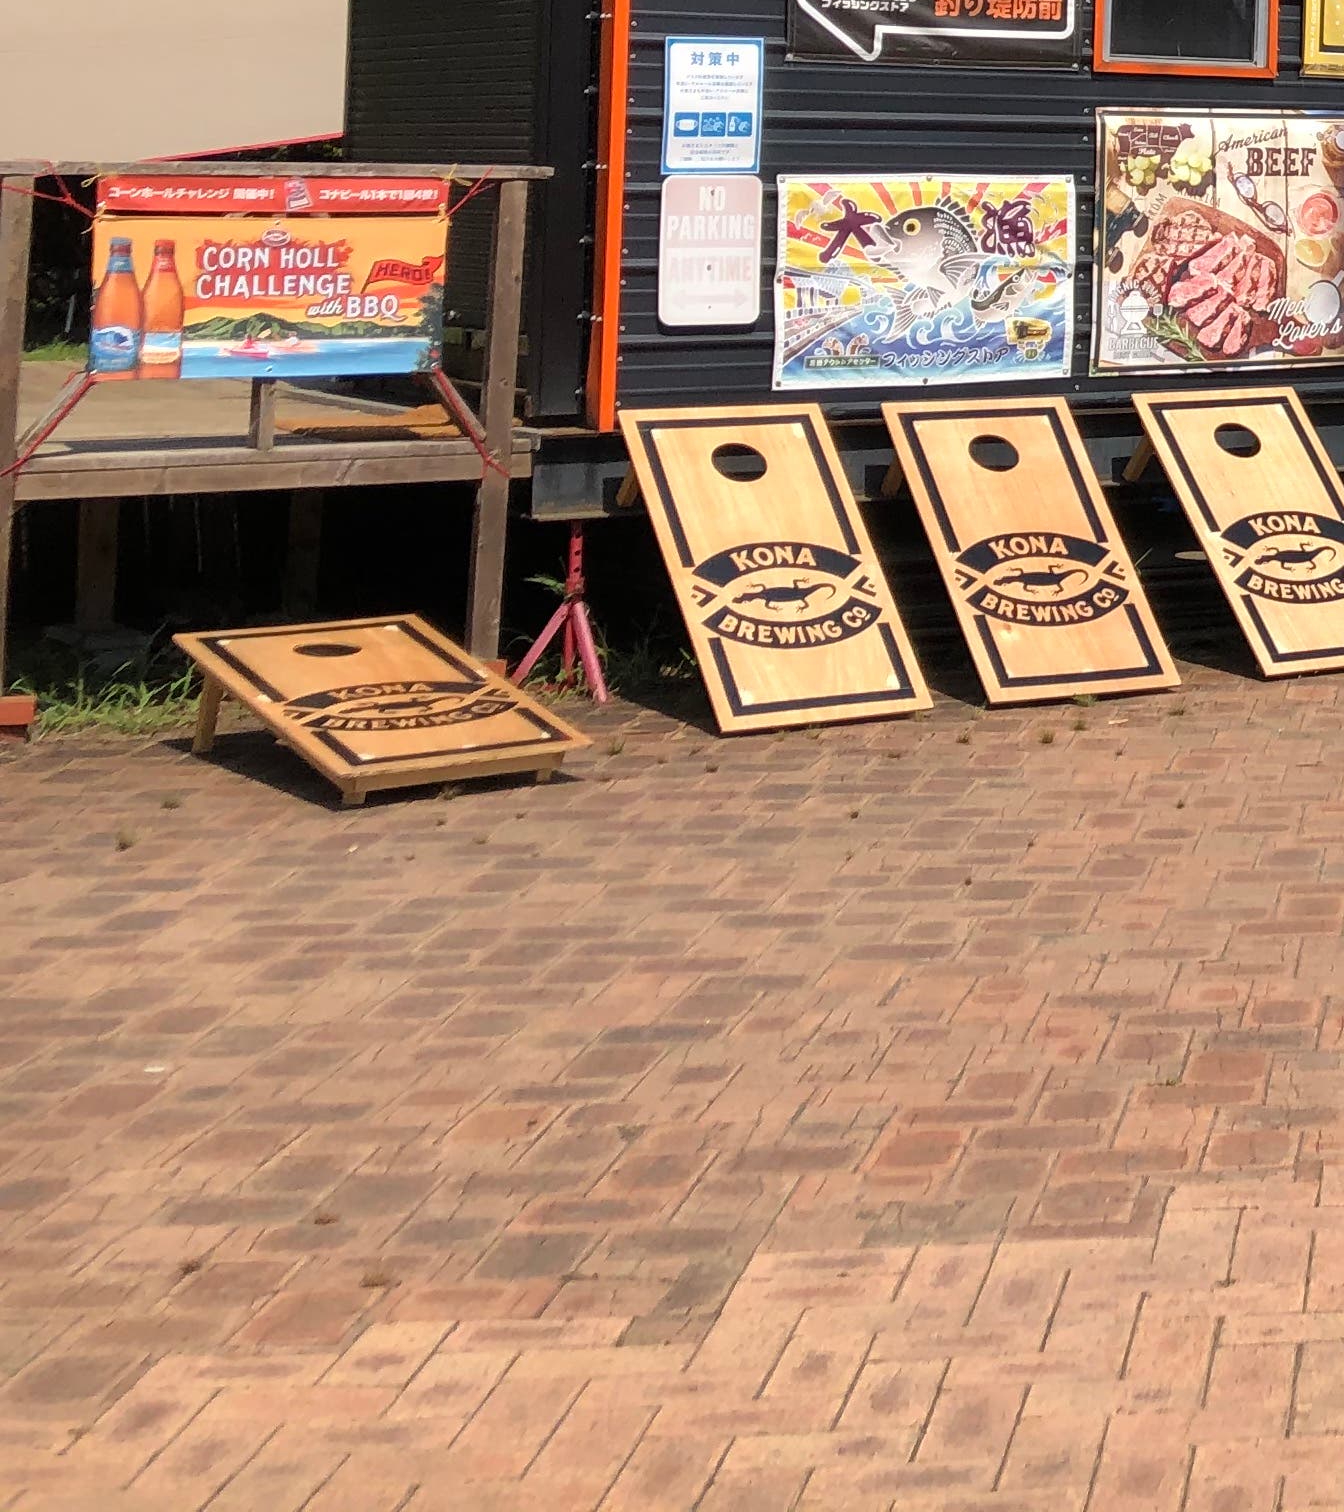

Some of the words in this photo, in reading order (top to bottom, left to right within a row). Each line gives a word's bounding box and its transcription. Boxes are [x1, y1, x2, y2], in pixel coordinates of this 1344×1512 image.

[690, 52, 740, 67] 対策中
[1218, 127, 1289, 155] American
[1246, 147, 1317, 177] BEEF
[699, 186, 727, 212] NO
[666, 214, 755, 241] PARKING
[202, 246, 270, 273] CORN
[280, 245, 340, 269] HOLL
[196, 273, 351, 300] CHALLENGE
[306, 299, 344, 319] with
[344, 294, 405, 321] BBQ
[1267, 295, 1309, 324] Mea
[881, 346, 1011, 369] フィッシングストア
[1247, 514, 1322, 537] KONA
[729, 544, 817, 572] KONA
[987, 535, 1069, 560] KONA
[979, 592, 1095, 623] BREWING
[717, 613, 843, 645] BREWING
[327, 682, 435, 701] KONA
[322, 709, 474, 731] BREWING
